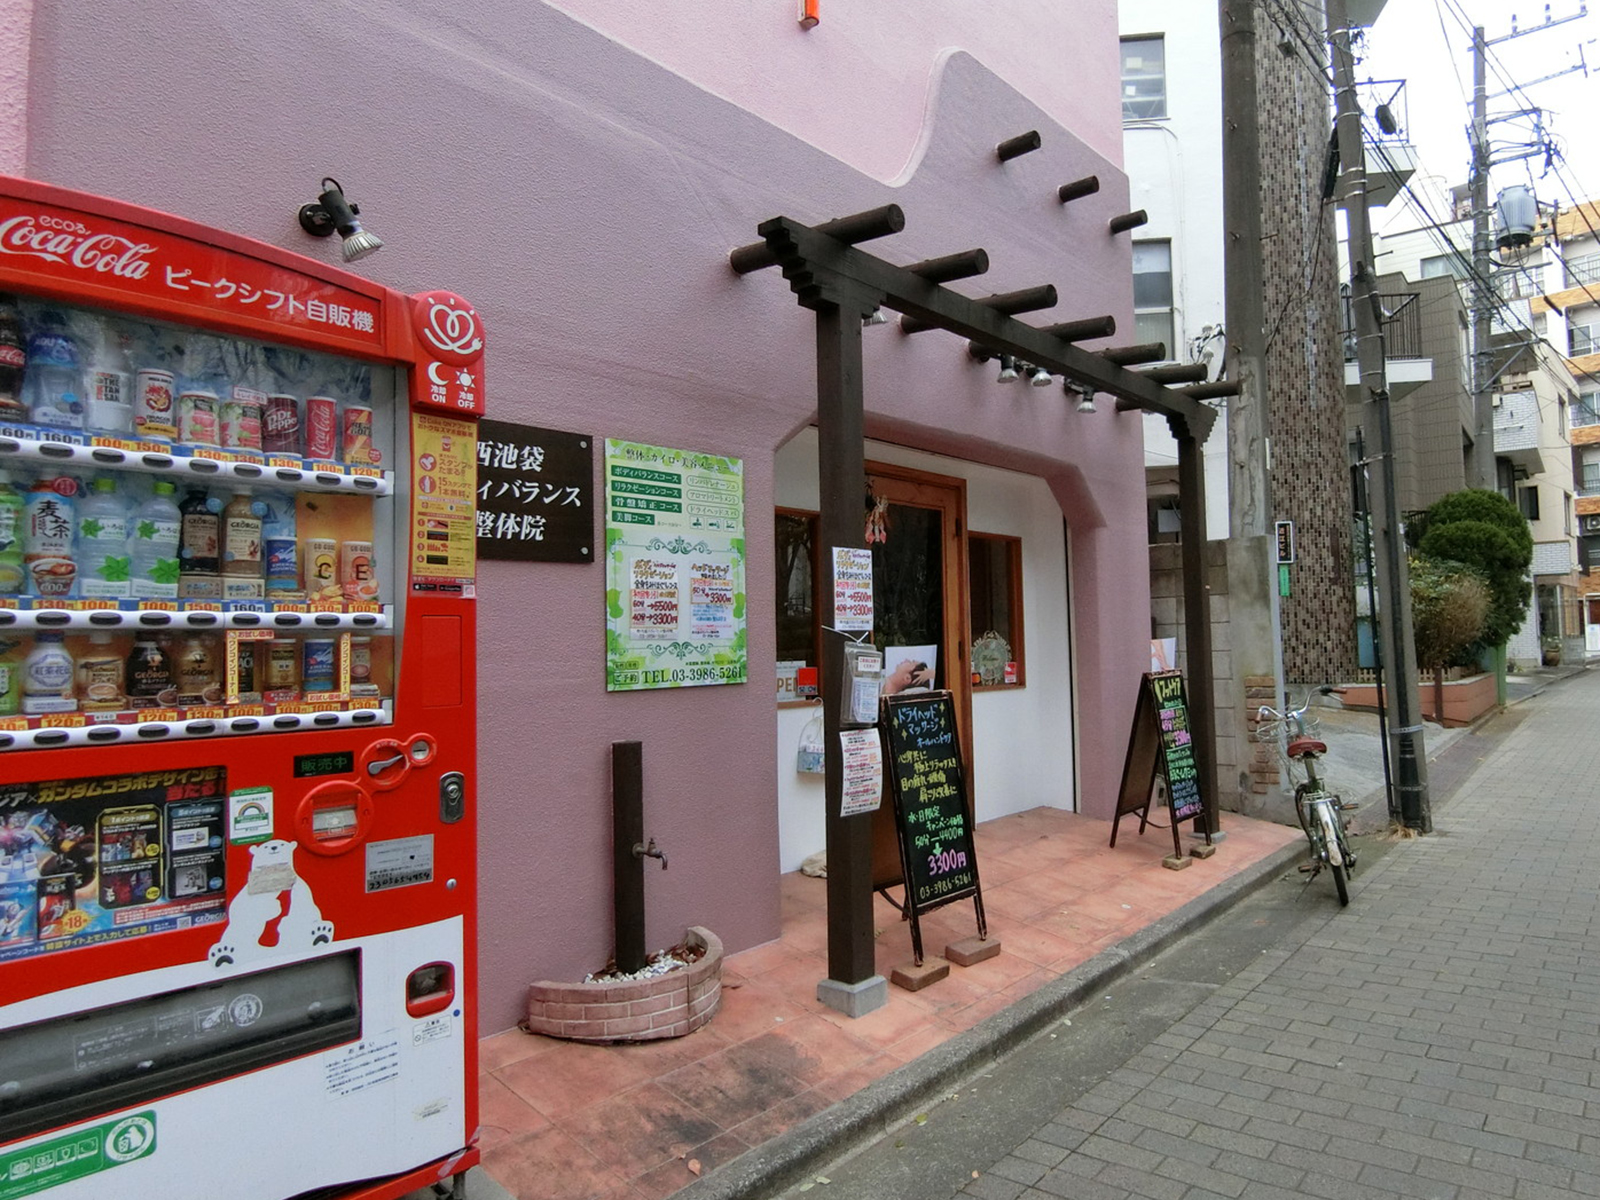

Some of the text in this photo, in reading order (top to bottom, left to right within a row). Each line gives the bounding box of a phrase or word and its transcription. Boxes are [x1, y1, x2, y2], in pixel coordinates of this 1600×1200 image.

[0, 216, 159, 280] Coca-Cola
[165, 265, 375, 334] ピークシフト自販機
[431, 394, 446, 404] ON
[457, 400, 476, 410] OFF
[277, 410, 292, 420] Dr
[43, 432, 82, 445] 160円
[94, 437, 130, 449] 100円
[196, 450, 229, 461] 130円
[477, 440, 545, 472] 西池袋
[271, 459, 301, 470] 130円
[353, 466, 379, 477] 120円
[614, 466, 679, 483] ボディバランスコース
[614, 482, 679, 498] リラクゼーションコース
[690, 505, 737, 517] ドライヘッドスパ
[37, 500, 71, 539] 麦茶
[476, 510, 547, 541] 整体院
[81, 601, 117, 610] 100円
[140, 602, 176, 611] 100円
[641, 665, 742, 684] TEL.03-3986-5261
[897, 703, 938, 724] ドライヘッド
[907, 717, 939, 735] マッサージ
[300, 756, 348, 772] 販売中
[927, 848, 967, 876] 3300円
[919, 871, 972, 900] 03-3986-5261
